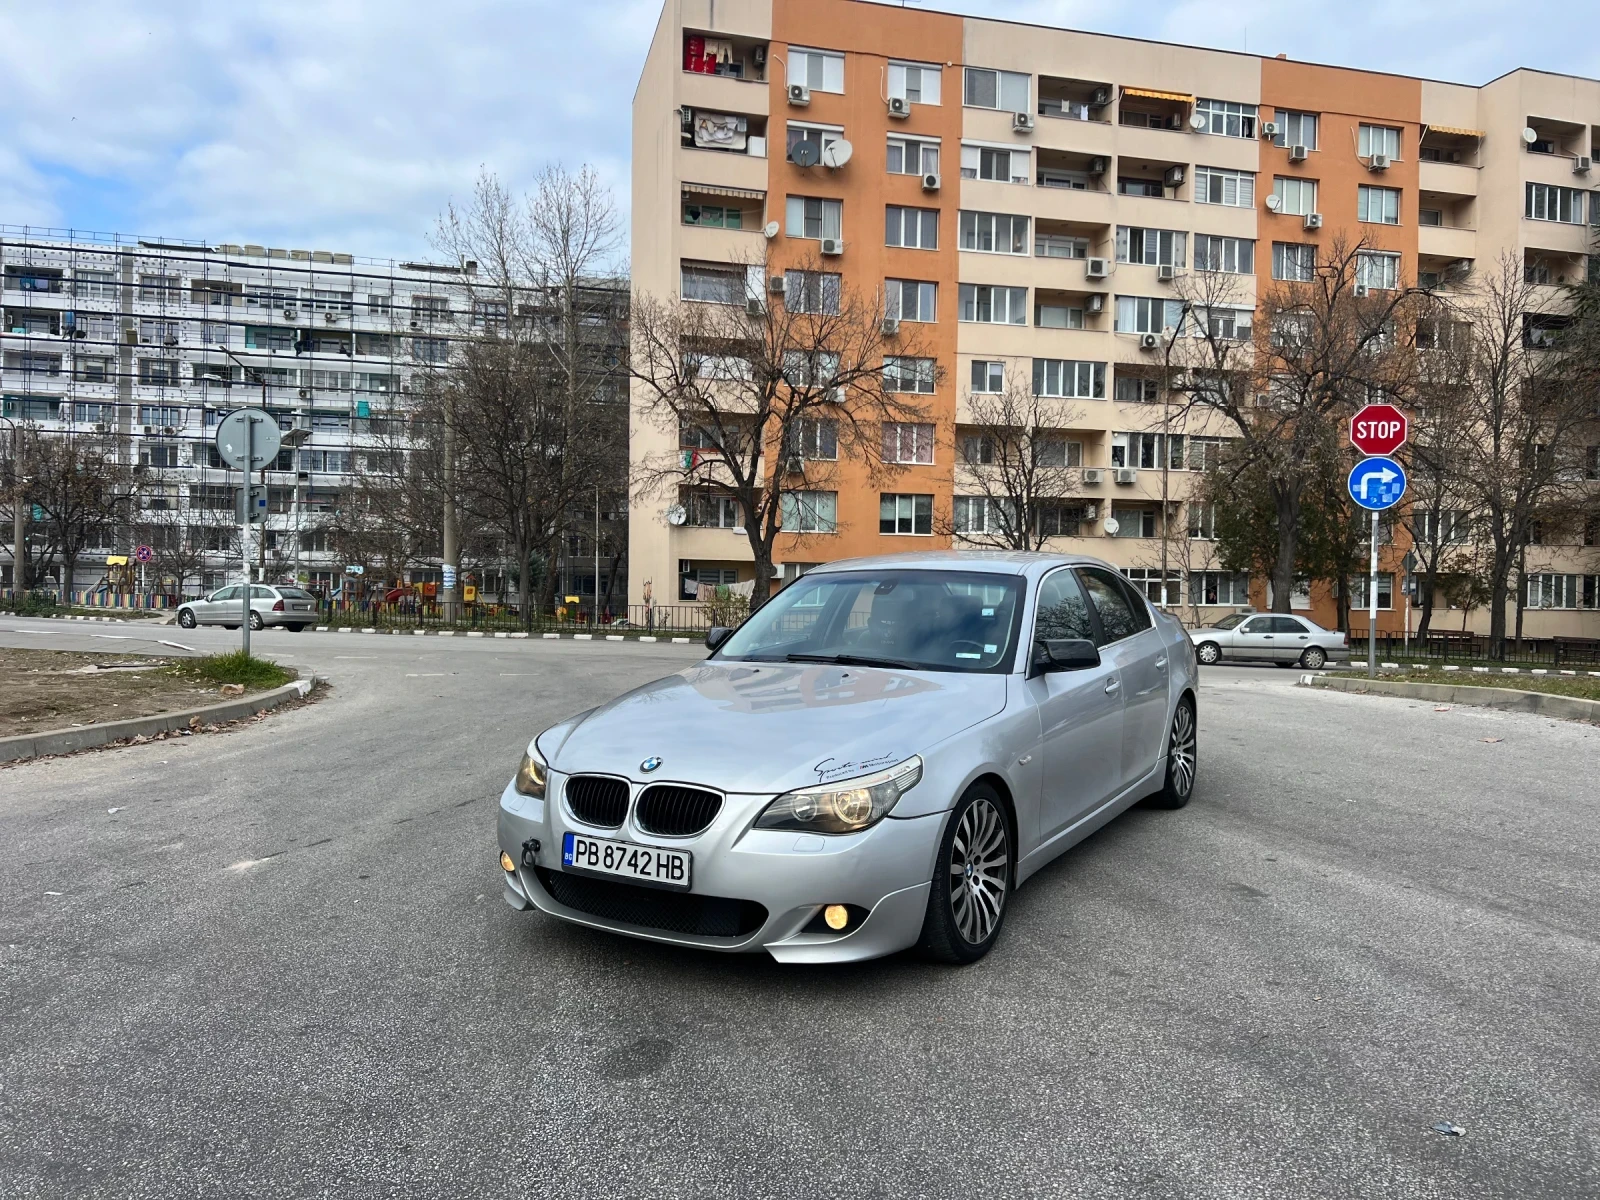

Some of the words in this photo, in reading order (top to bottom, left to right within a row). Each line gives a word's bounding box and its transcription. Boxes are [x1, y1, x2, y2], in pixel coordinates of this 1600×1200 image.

[1356, 421, 1401, 439] STOP
[564, 852, 573, 860] BG
[575, 839, 600, 866] PB
[603, 845, 652, 876] 8742
[656, 853, 685, 881] HB
